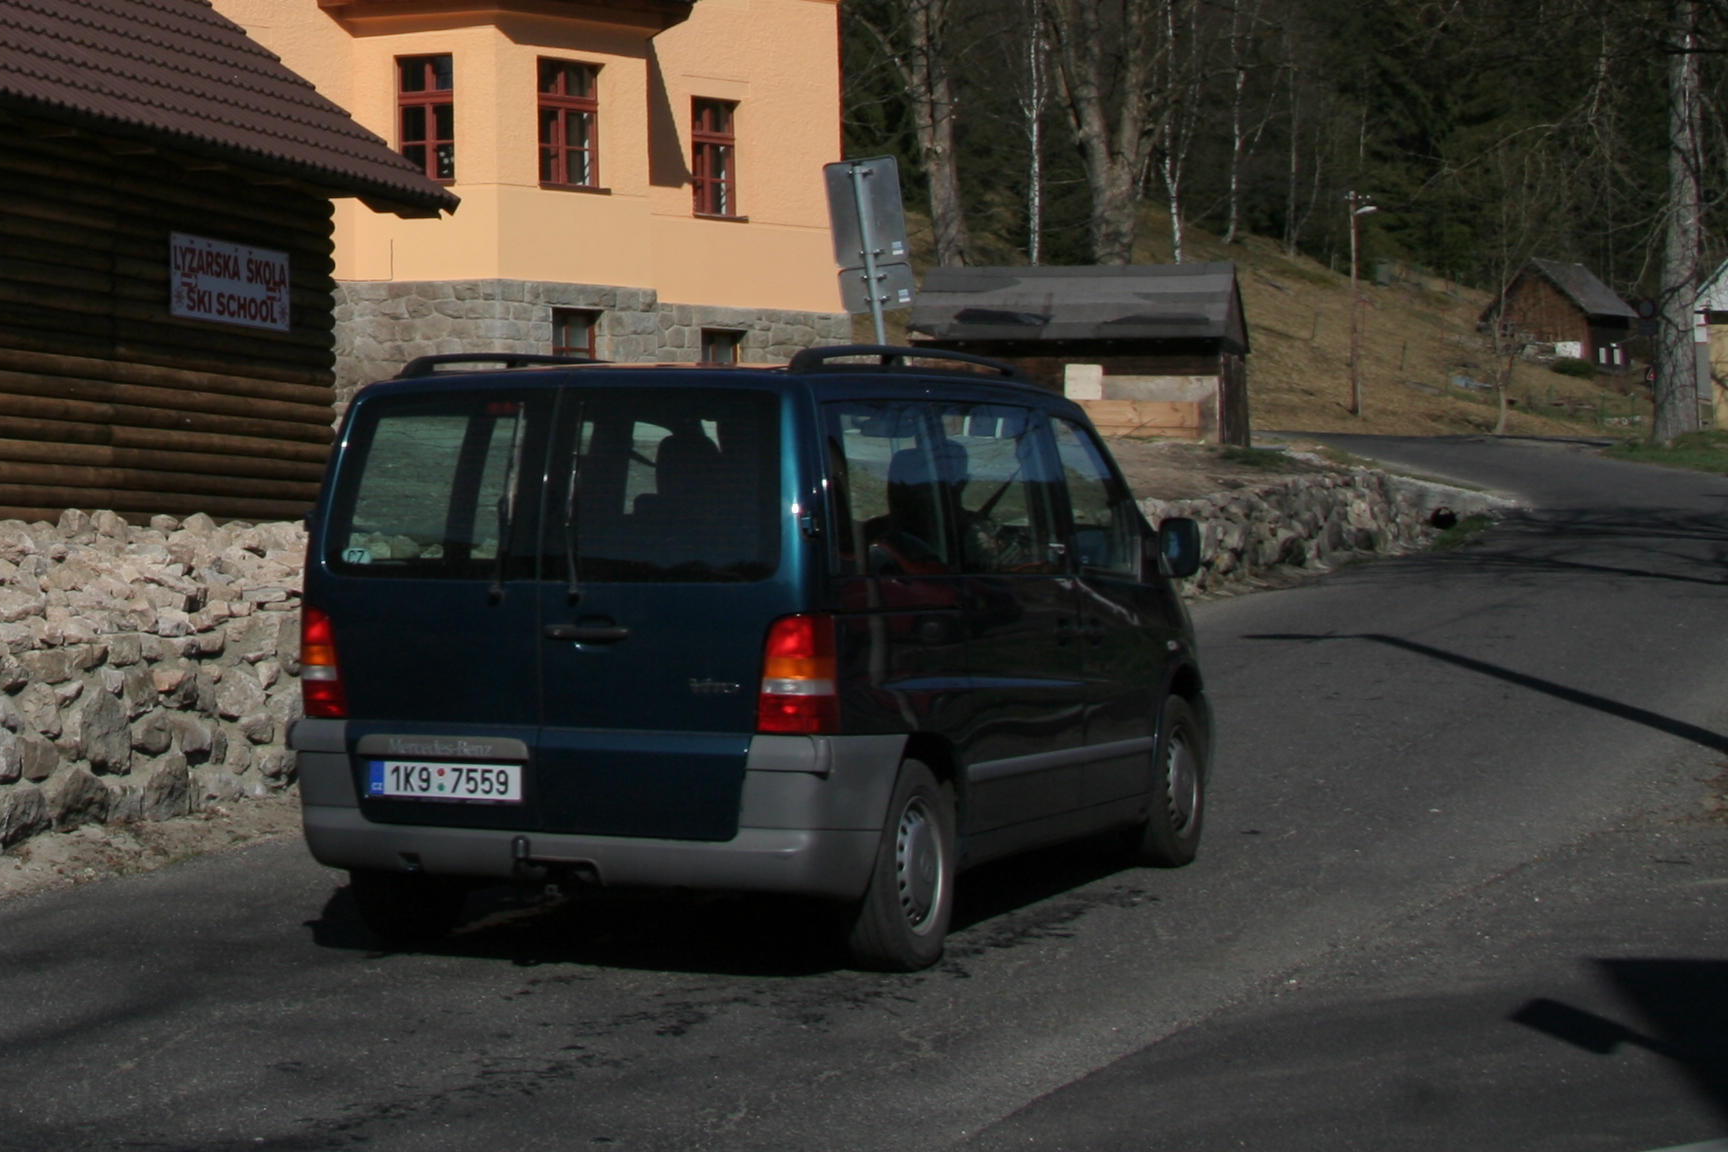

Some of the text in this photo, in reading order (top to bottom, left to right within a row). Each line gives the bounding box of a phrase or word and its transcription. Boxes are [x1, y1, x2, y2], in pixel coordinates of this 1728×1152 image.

[173, 240, 287, 288] LYŽAŘSKÁ ŠKOLA
[186, 287, 277, 323] SKI SCHOOL
[387, 739, 492, 756] Mercedes-Benz
[391, 766, 508, 794] 1K9 7559
